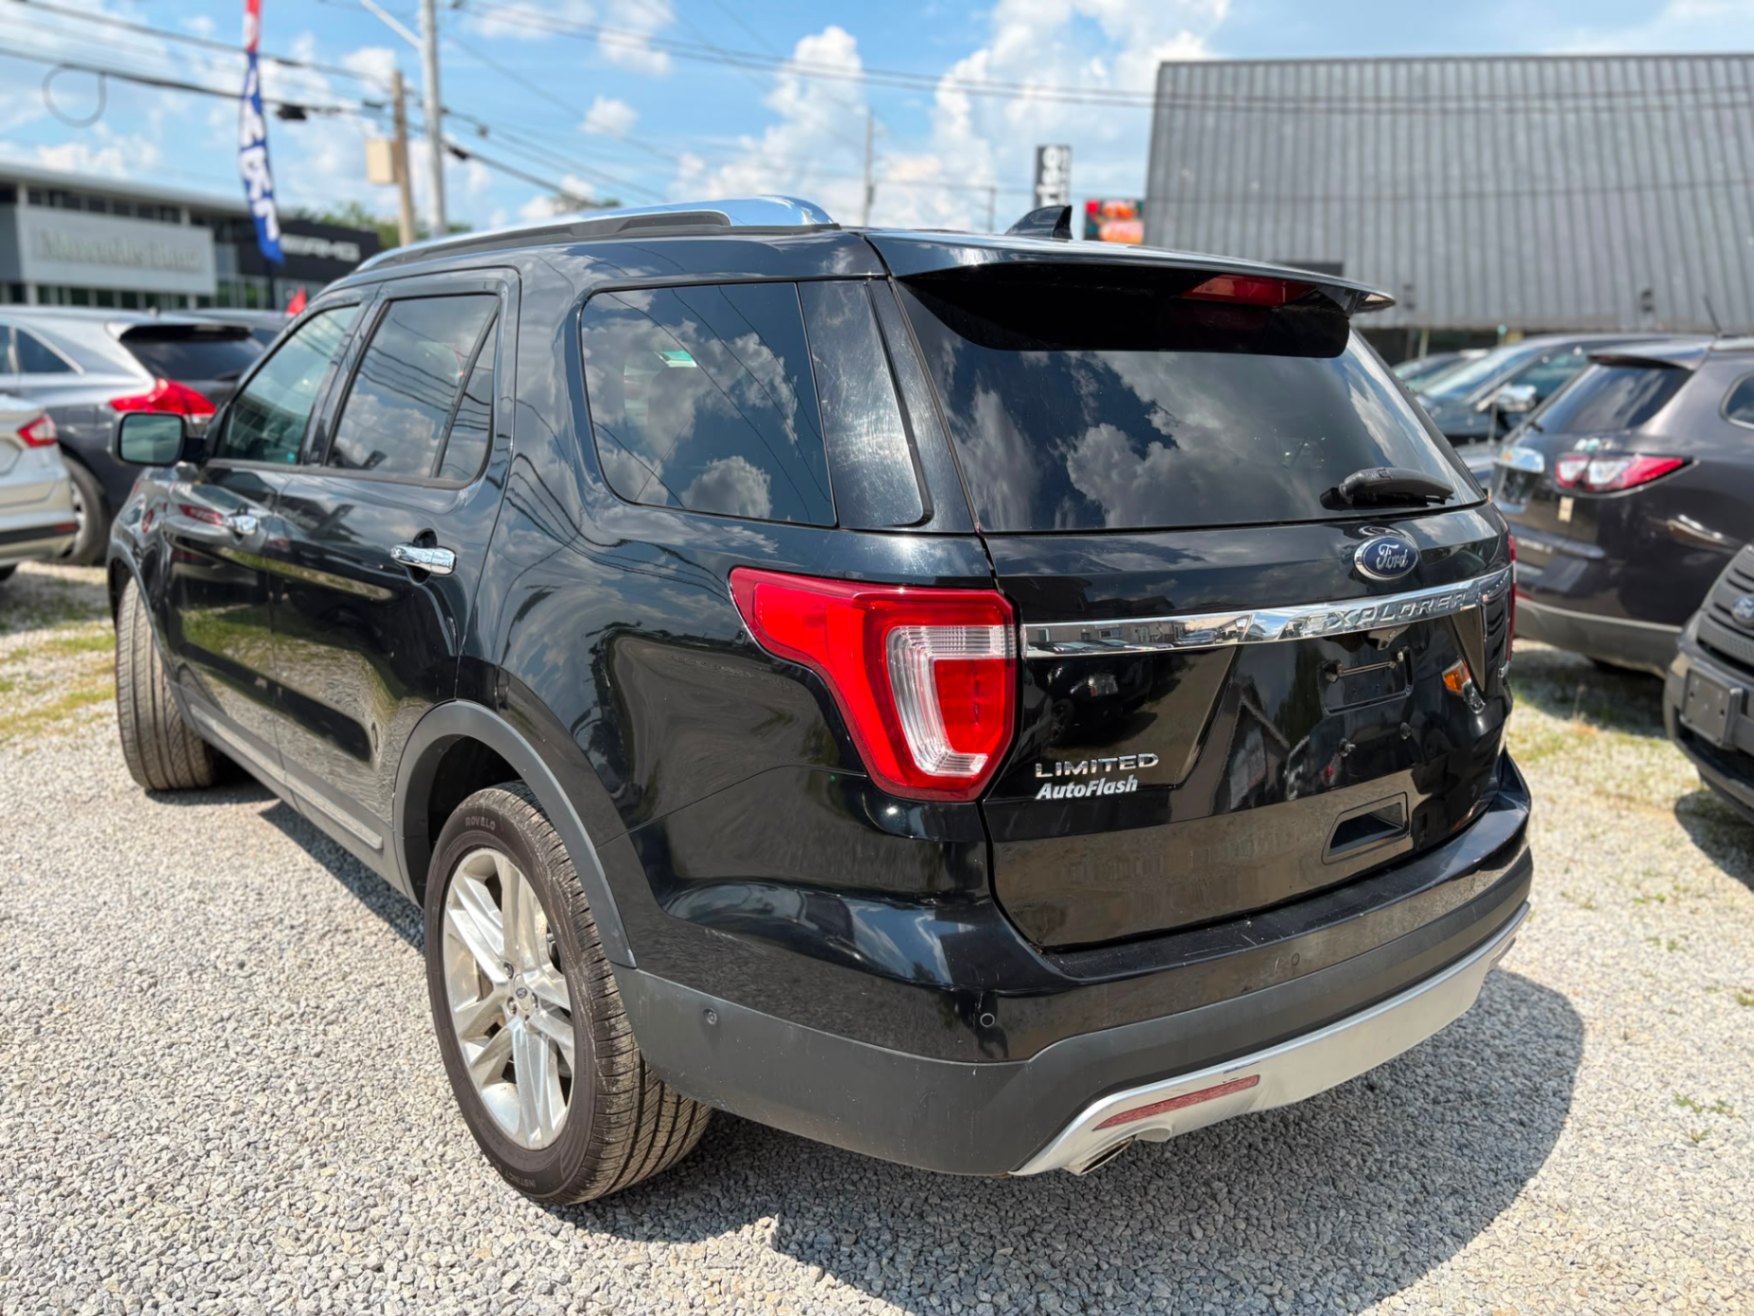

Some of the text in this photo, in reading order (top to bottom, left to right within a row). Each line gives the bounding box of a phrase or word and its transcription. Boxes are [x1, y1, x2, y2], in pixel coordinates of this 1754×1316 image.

[1375, 543, 1409, 571] Ford
[1300, 594, 1467, 636] EXPLORER
[1035, 753, 1159, 778] LIMITED
[1035, 774, 1138, 800] AutoFlash
